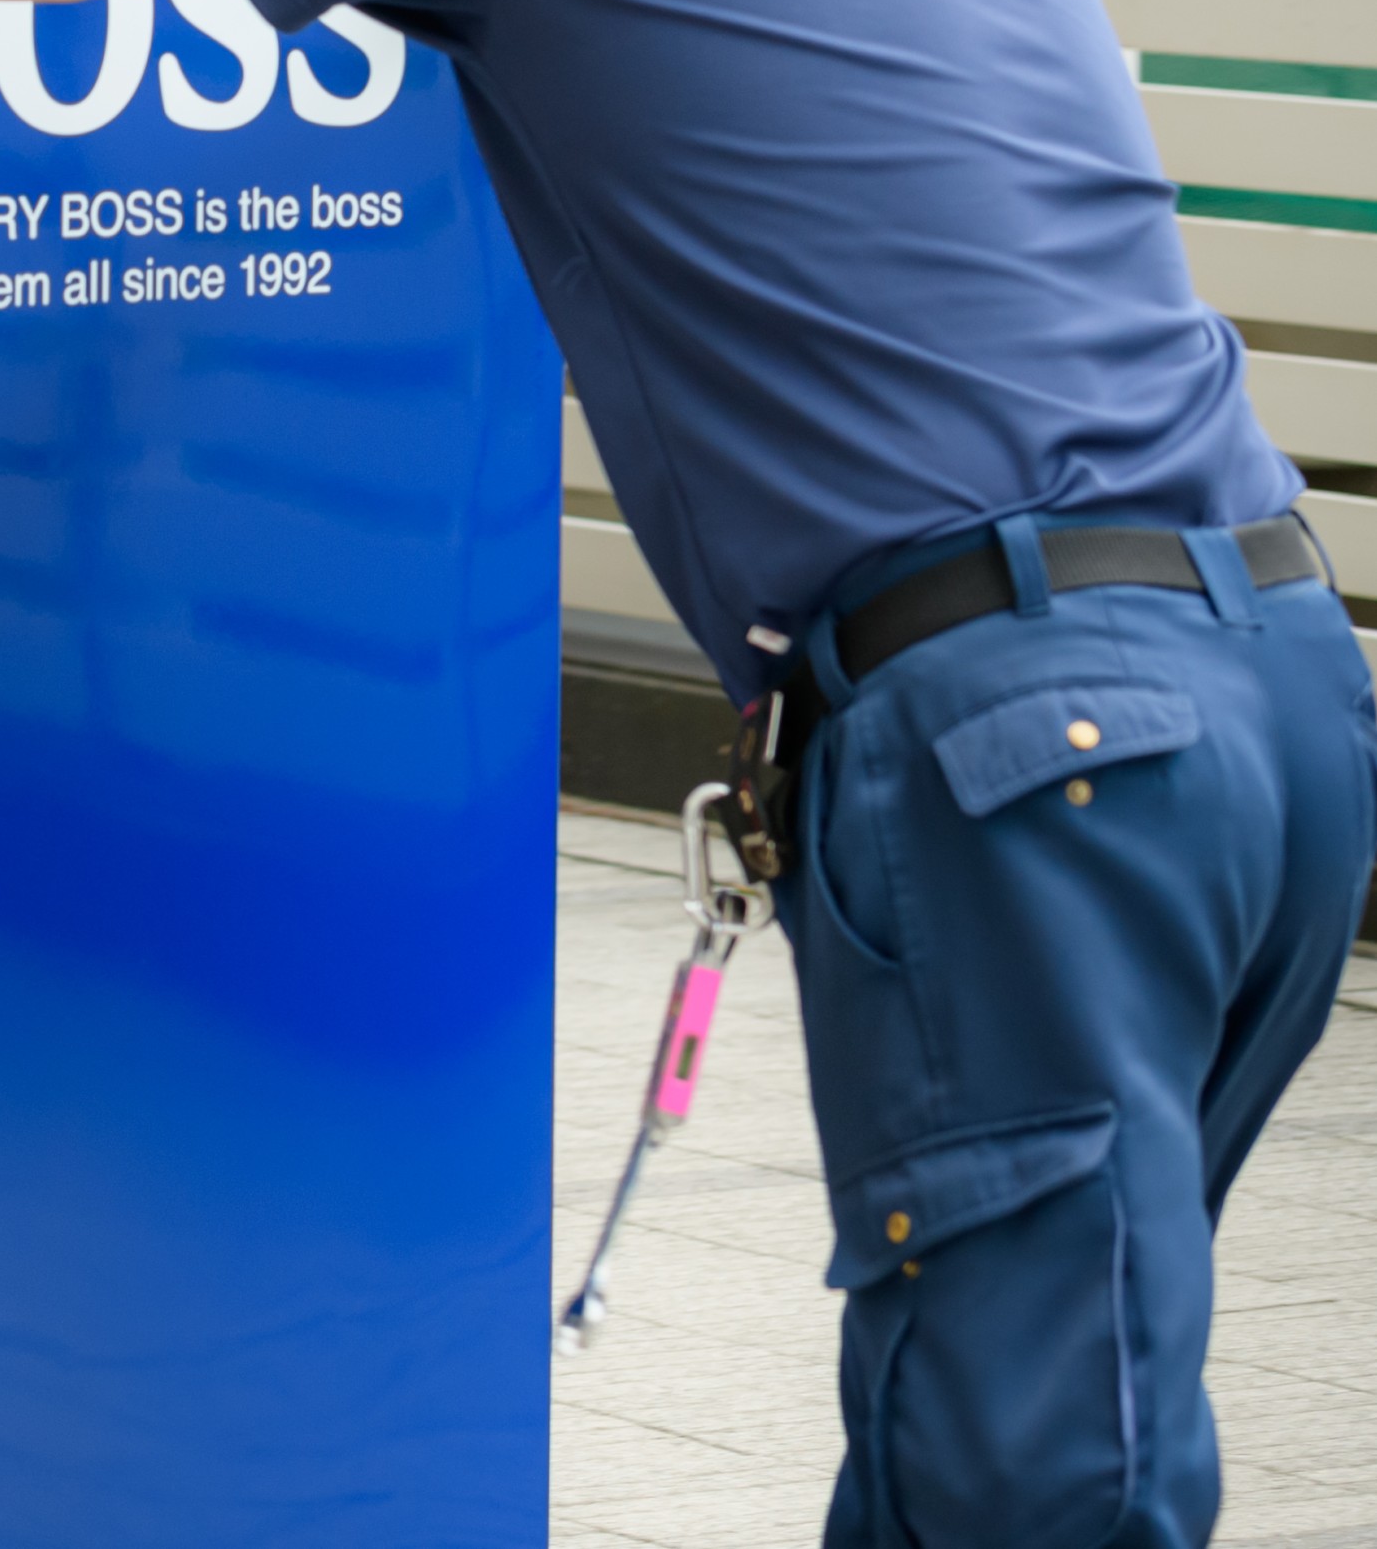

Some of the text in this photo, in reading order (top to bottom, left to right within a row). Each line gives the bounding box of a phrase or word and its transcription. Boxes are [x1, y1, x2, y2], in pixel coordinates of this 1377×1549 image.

[60, 188, 184, 239] BOSS
[196, 189, 228, 233] is
[238, 186, 300, 232] the
[311, 184, 403, 230] boss
[62, 259, 111, 304] all
[122, 257, 226, 304] since
[240, 251, 333, 296] 1992
